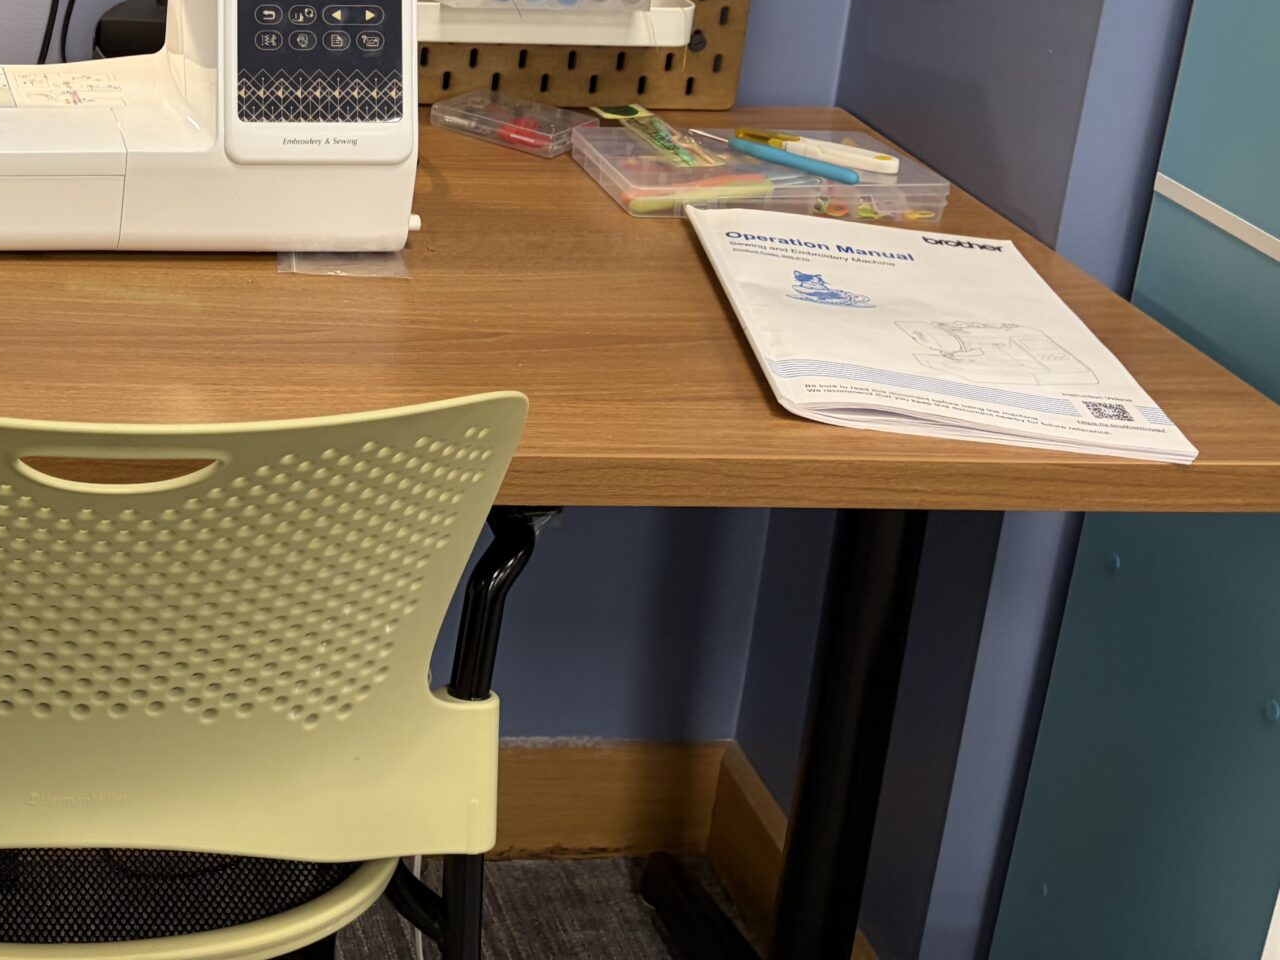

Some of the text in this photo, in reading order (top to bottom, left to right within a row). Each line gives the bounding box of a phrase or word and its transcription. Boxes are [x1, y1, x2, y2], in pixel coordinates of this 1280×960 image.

[282, 137, 322, 147] Embroidery
[332, 137, 358, 147] Sewing
[725, 230, 915, 262] Operation Manual
[729, 240, 767, 251] Sewing
[769, 245, 789, 254] and
[790, 248, 849, 263] Embroidery
[851, 257, 896, 268] Machine
[921, 235, 1003, 253] brother
